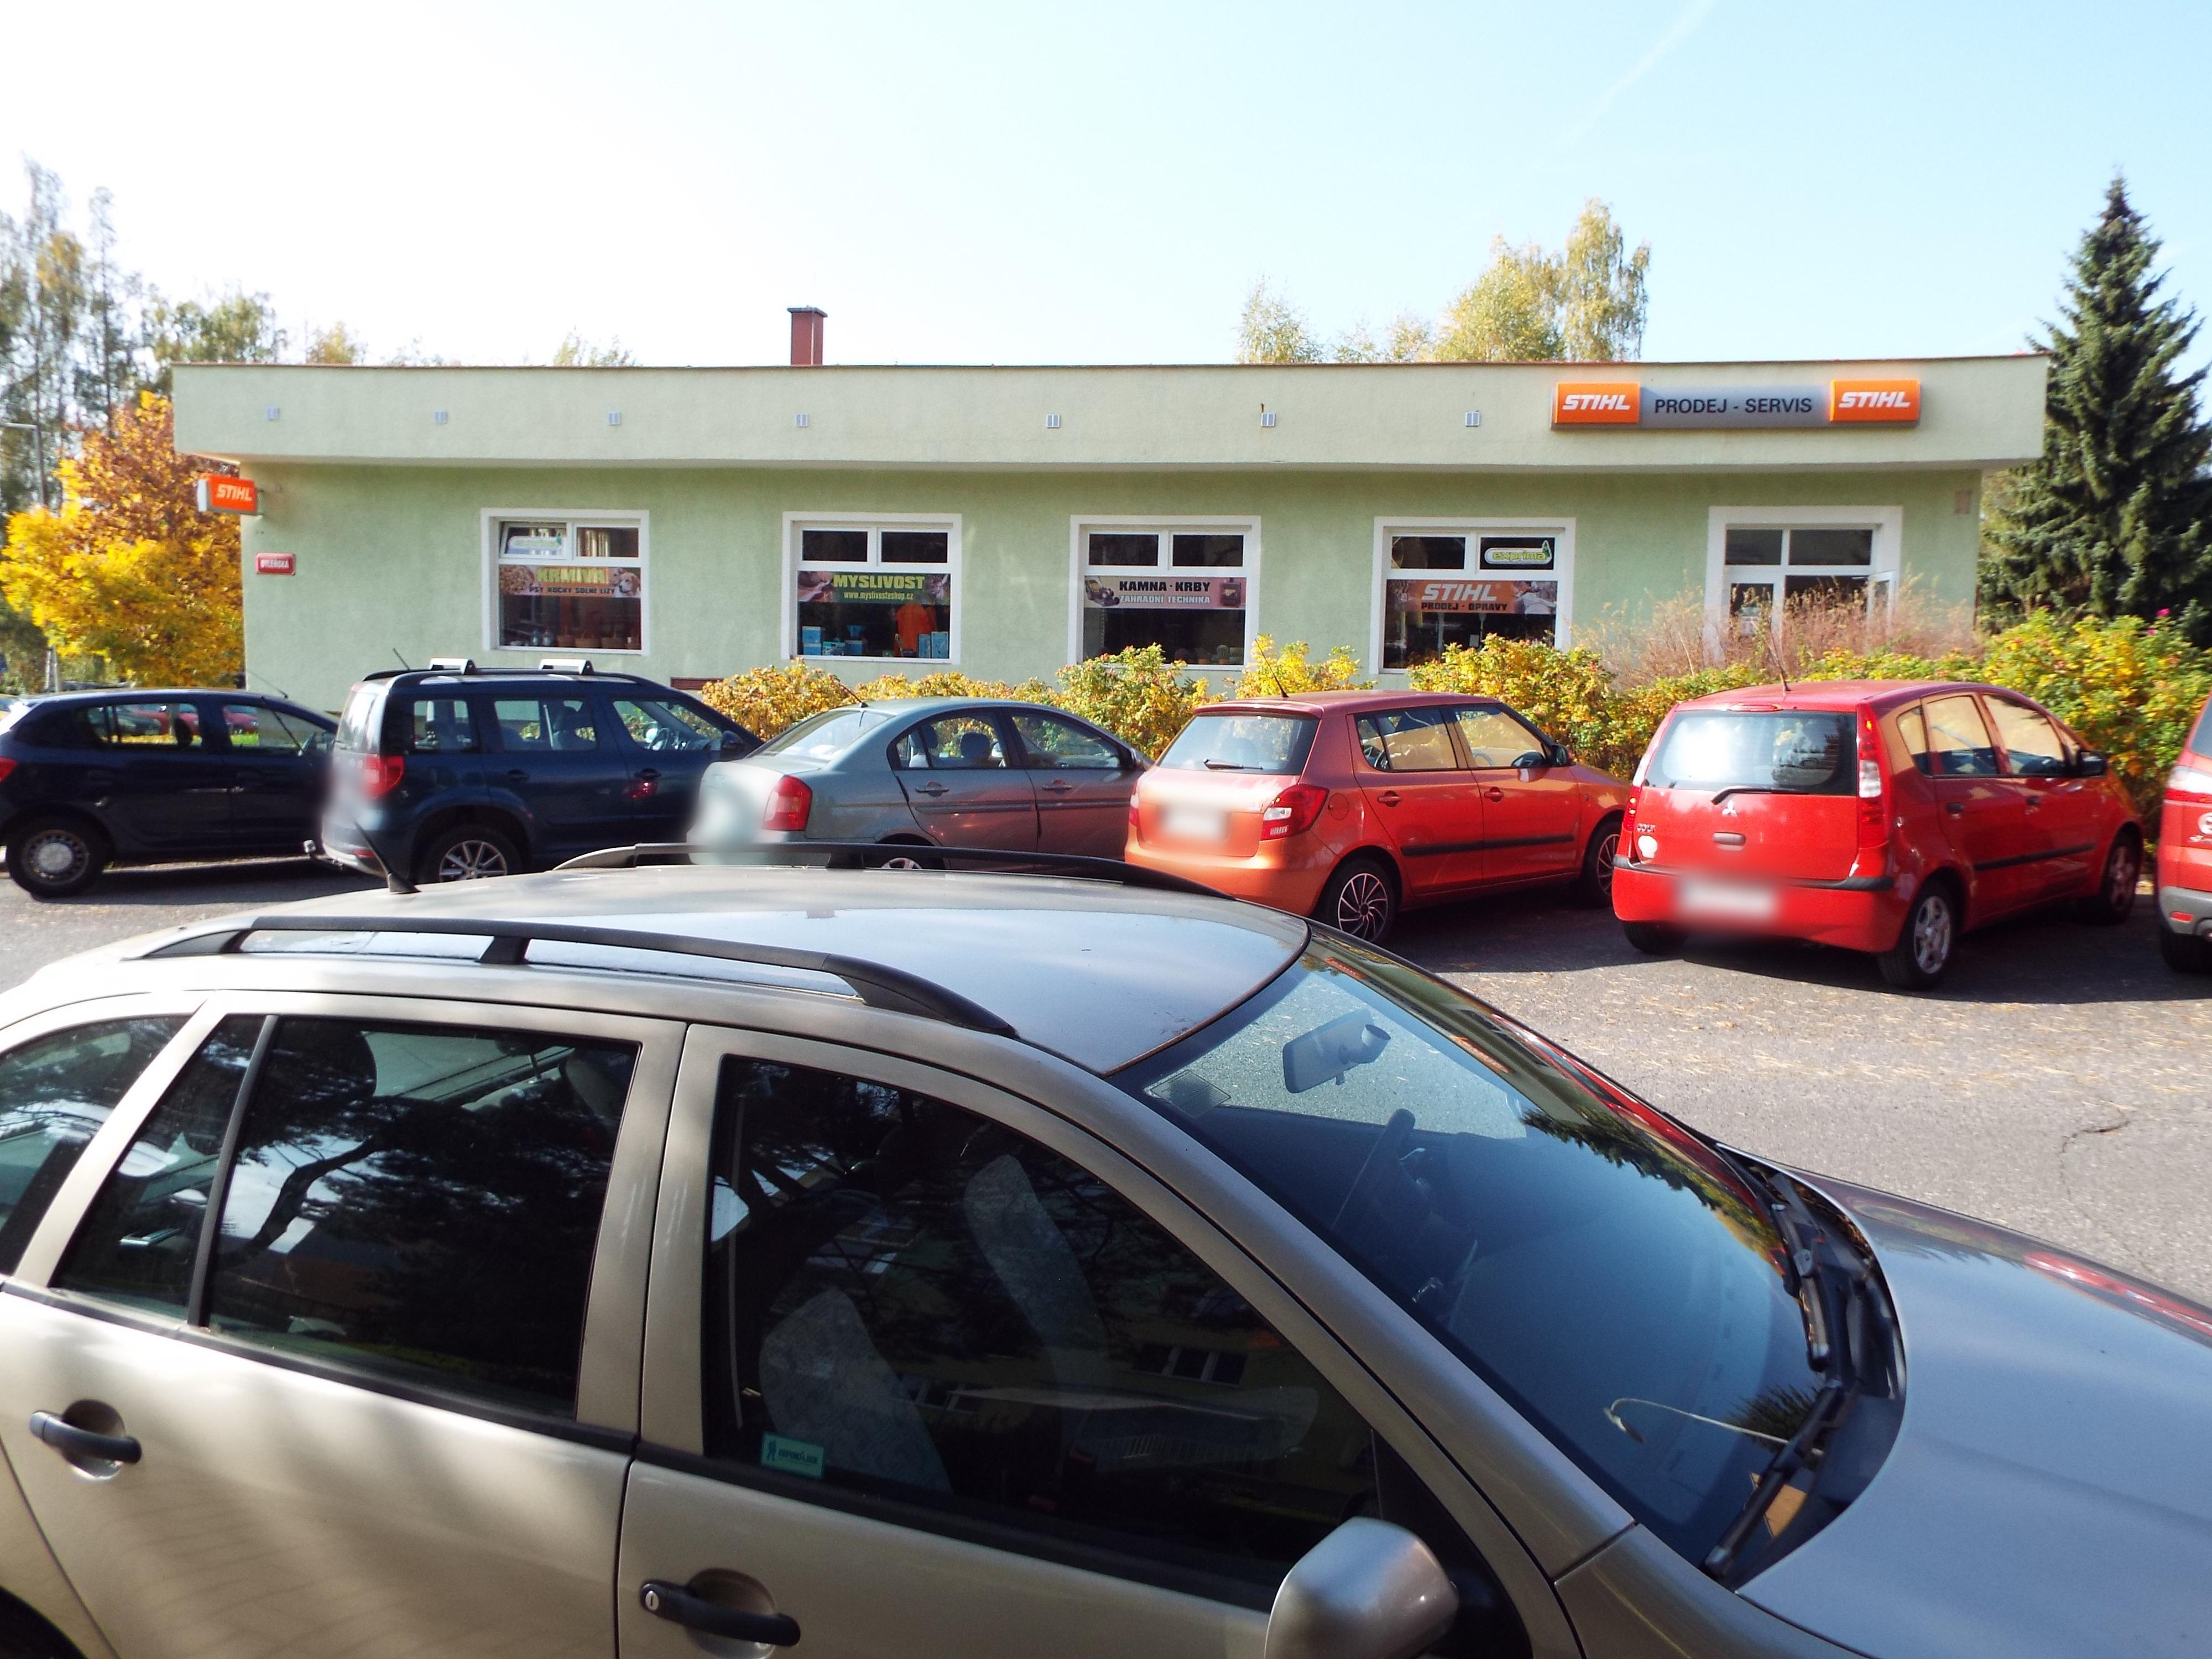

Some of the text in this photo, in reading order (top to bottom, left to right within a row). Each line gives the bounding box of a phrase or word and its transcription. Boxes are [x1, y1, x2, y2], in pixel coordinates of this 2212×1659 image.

[1562, 394, 1630, 410] STIHL
[1655, 399, 1726, 414] PRODEJ
[1745, 398, 1812, 413] SERVIS
[1839, 391, 1911, 408] STIHL
[216, 483, 253, 502] STIHL
[1493, 550, 1547, 562] exprima
[833, 575, 925, 589] MYSLIVOST
[1119, 581, 1167, 591] KAMNA
[1175, 582, 1211, 592] KRBY
[844, 591, 914, 601] www.myslivosteshop.cz
[1422, 583, 1498, 601] STIHL
